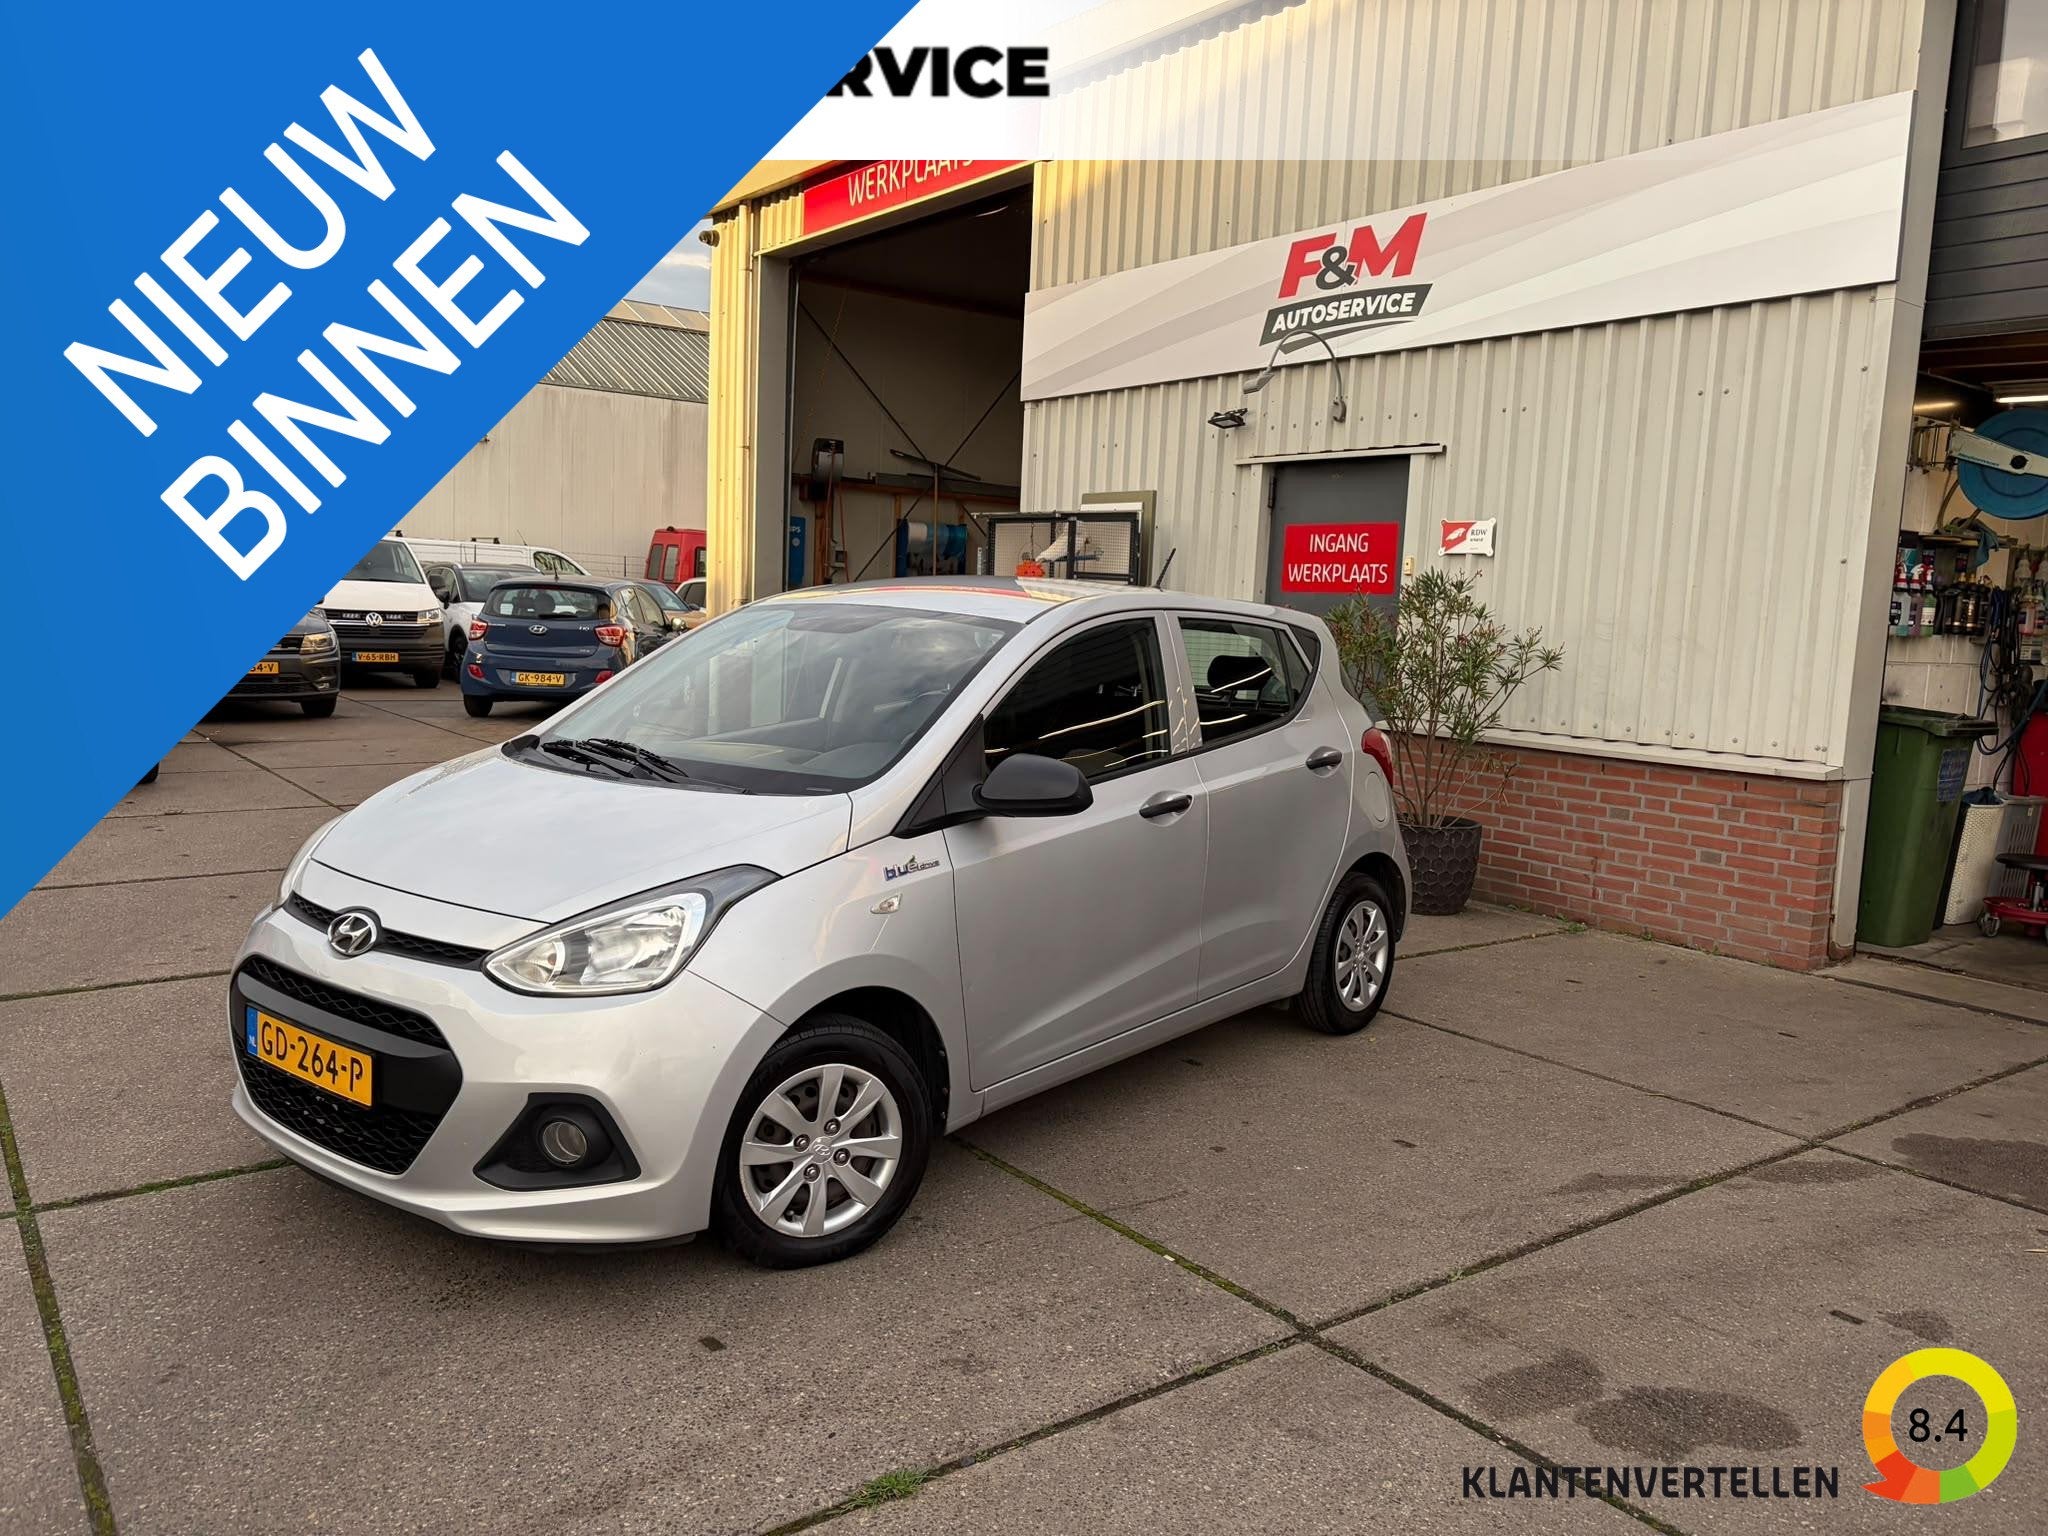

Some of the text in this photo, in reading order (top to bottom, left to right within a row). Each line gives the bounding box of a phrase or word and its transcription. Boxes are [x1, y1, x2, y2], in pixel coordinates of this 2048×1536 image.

[1278, 212, 1428, 299] F&M
[1271, 292, 1417, 334] AUTOSERVICE
[1309, 533, 1369, 553] INGANG
[1288, 563, 1388, 584] WERKPLAATS
[518, 673, 562, 683] GK-984-V
[261, 1020, 364, 1093] GD-264-P
